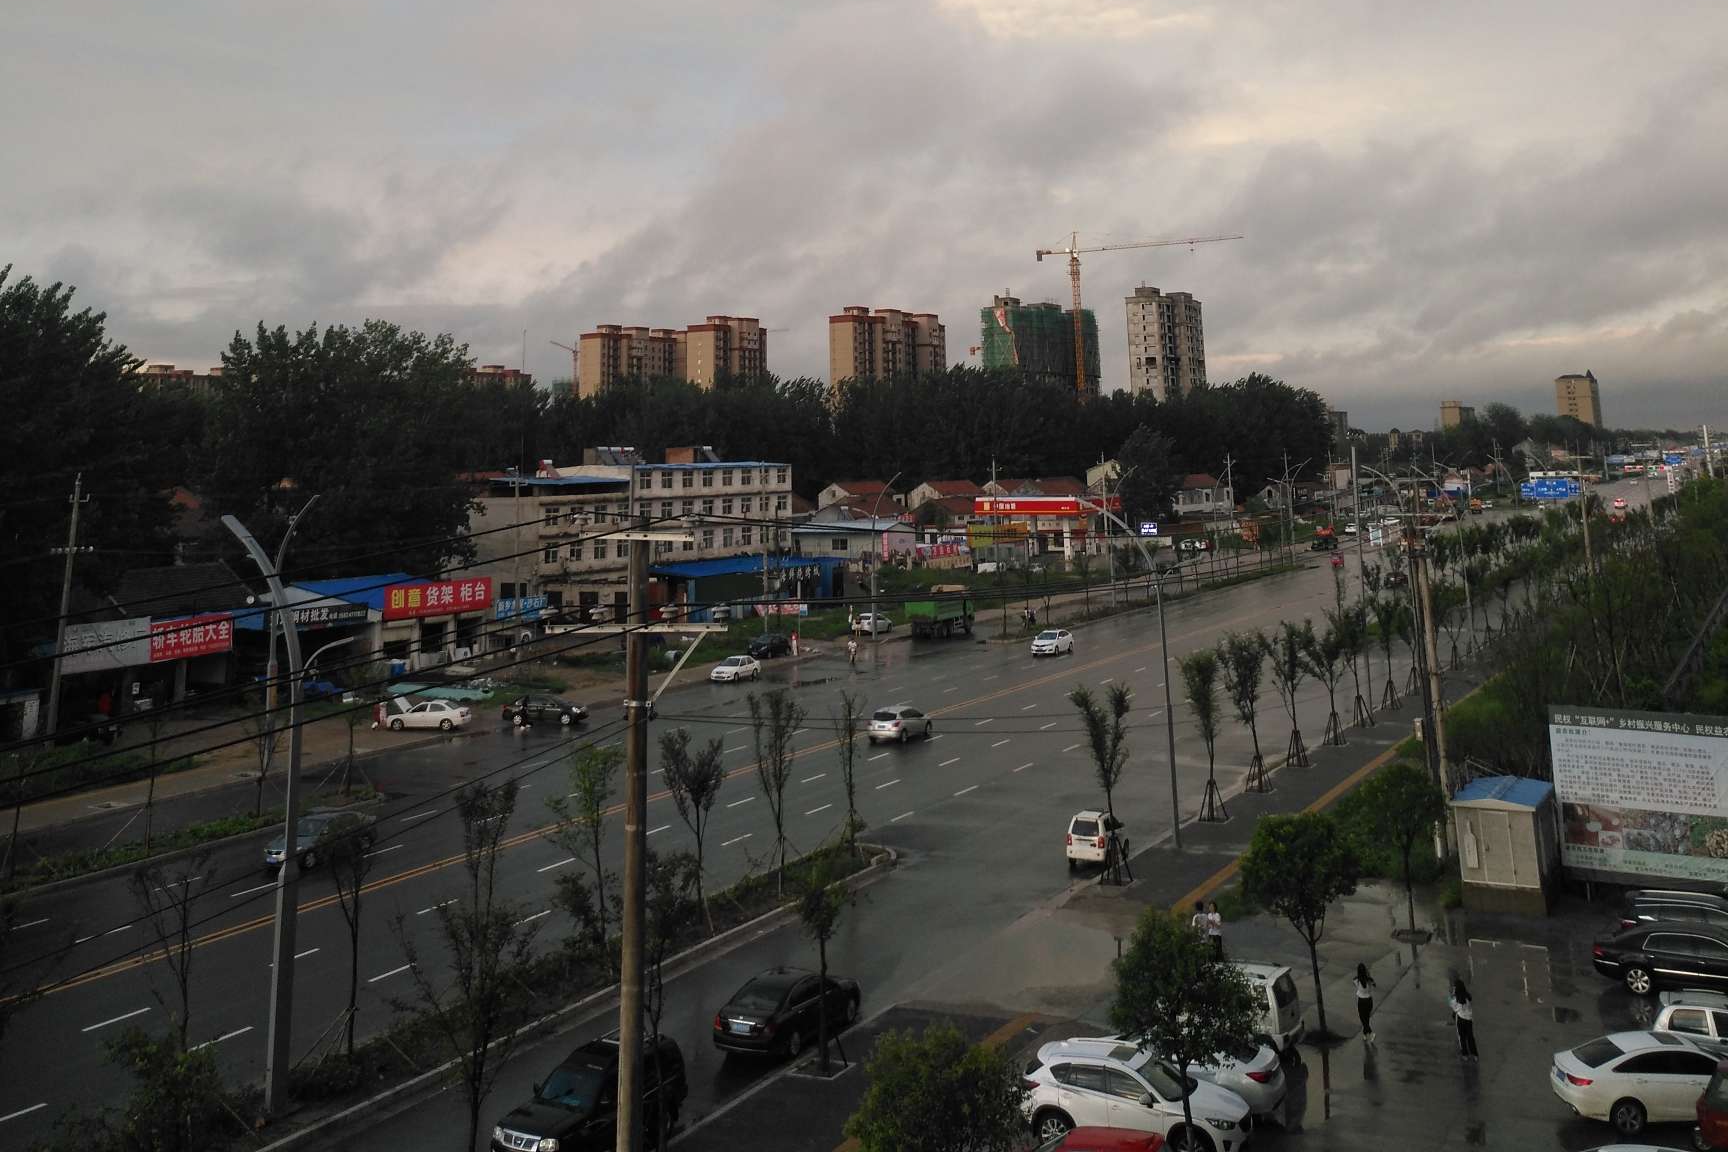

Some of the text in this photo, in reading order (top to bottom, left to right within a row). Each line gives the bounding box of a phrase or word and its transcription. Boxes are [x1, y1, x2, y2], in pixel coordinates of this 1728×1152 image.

[391, 581, 486, 609] 创意 货架 柜台
[152, 621, 229, 650] 轿车轮胎大全
